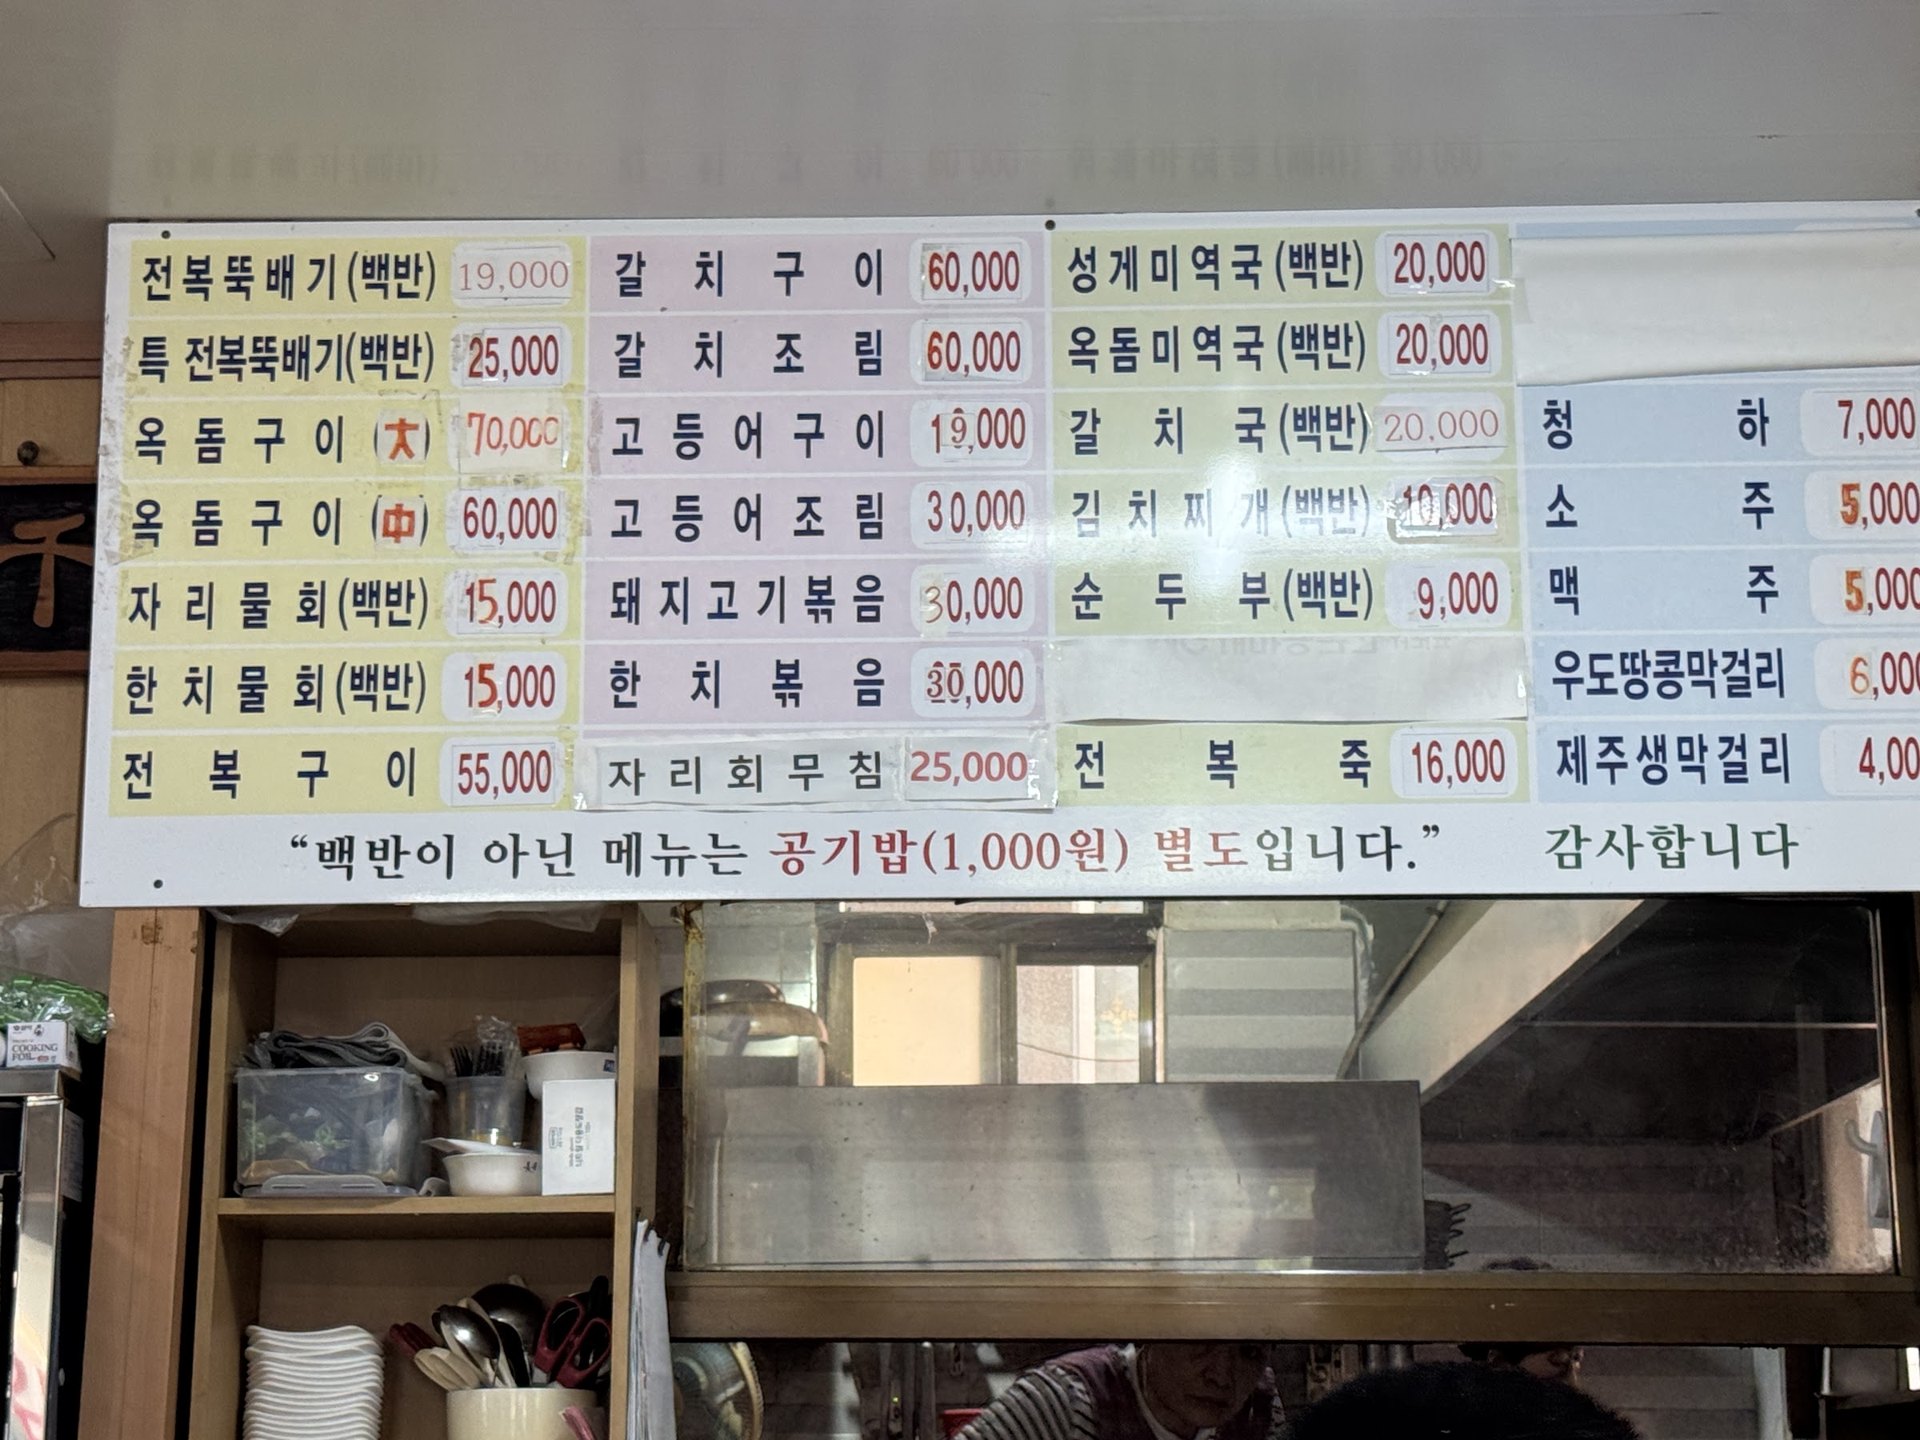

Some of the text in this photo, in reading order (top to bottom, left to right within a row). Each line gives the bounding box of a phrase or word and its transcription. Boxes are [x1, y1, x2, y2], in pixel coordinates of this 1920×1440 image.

[458, 260, 569, 292] 19,000
[928, 250, 1020, 297] 60,000
[1393, 240, 1486, 288] 20,000
[137, 330, 559, 384] 특 전복뚝배기(백반) 25,000
[927, 330, 1021, 378] 60,000
[1396, 323, 1489, 367] 20,000
[931, 407, 1026, 454] 19,000
[1386, 410, 1499, 442] 20,000
[1837, 397, 1916, 445] 7,000
[463, 496, 557, 545] 60,000
[927, 489, 1025, 534] 30,000
[1840, 481, 1920, 530] 5,000
[465, 578, 557, 629] 15,000
[925, 576, 1023, 625] 30,000
[1417, 571, 1499, 620] 9,000
[1845, 567, 1920, 616] 5,000
[464, 662, 556, 713] 15,000
[926, 660, 1024, 709] 30,000
[458, 749, 552, 800] 55,000
[910, 751, 1028, 787] 25,000
[1411, 738, 1506, 789] 16,000
[483, 831, 576, 880] 아닌
[602, 831, 749, 879] 메뉴는
[768, 827, 1128, 878] 공기밥(1,000원)
[1544, 822, 1800, 871] 감사합니다
[11, 1043, 58, 1052] COOKING
